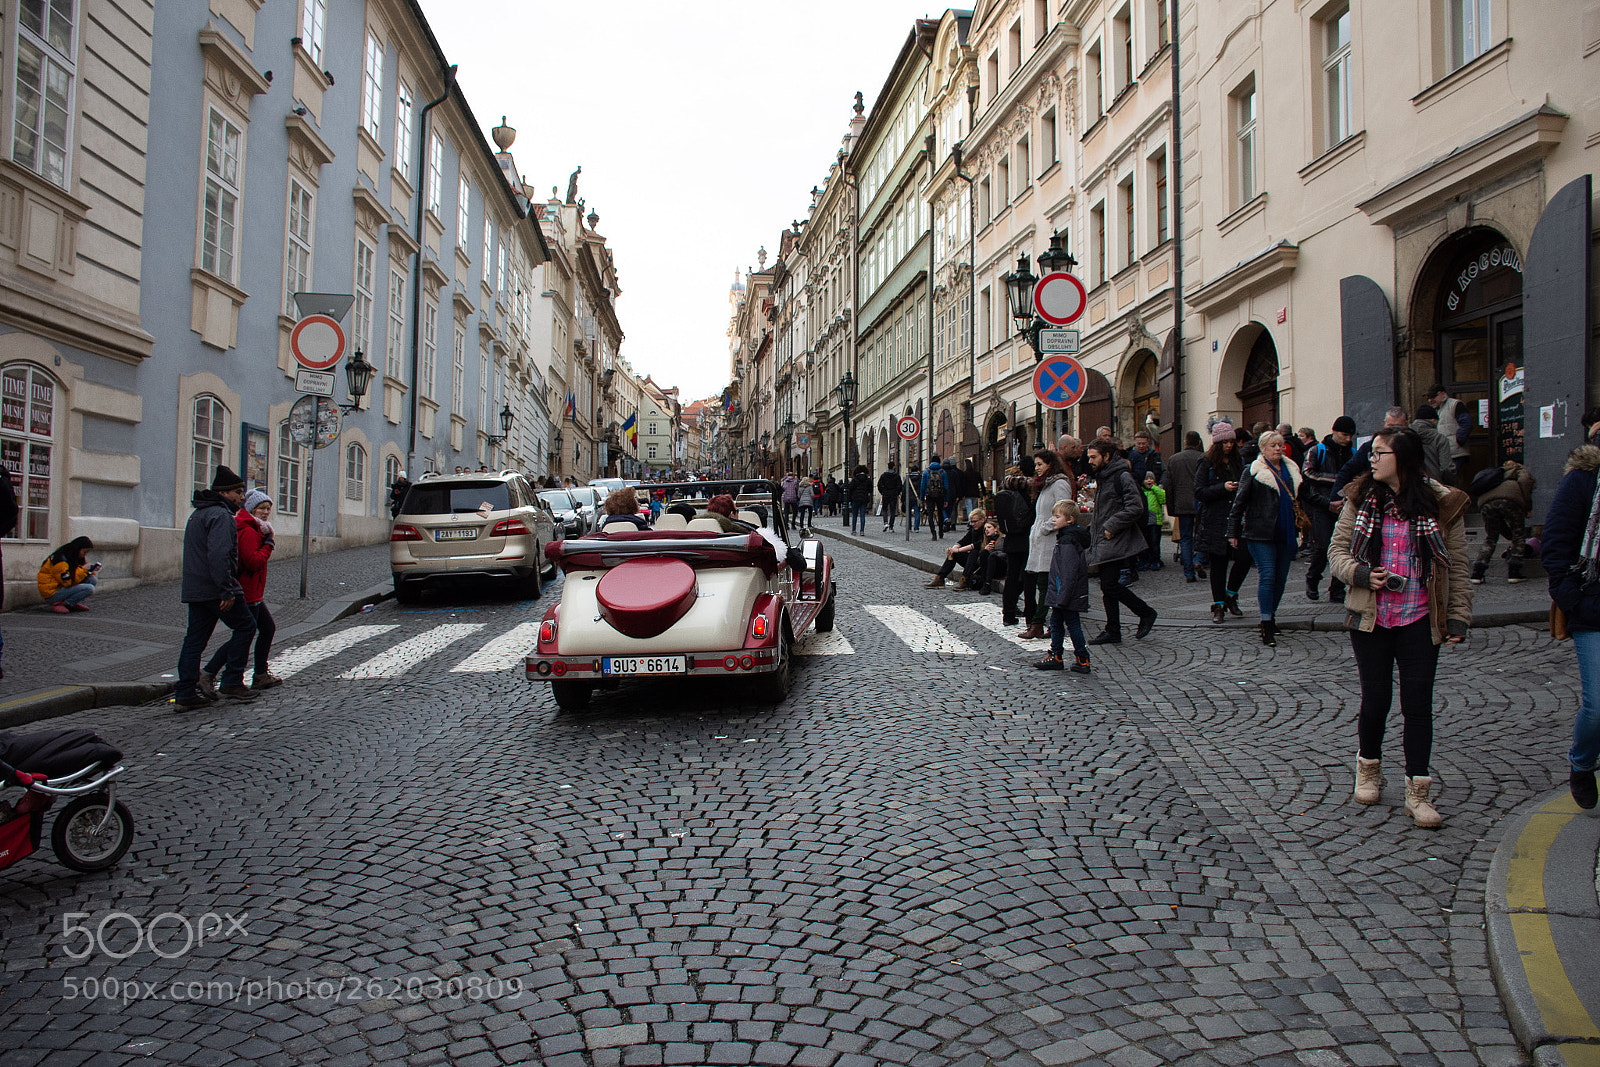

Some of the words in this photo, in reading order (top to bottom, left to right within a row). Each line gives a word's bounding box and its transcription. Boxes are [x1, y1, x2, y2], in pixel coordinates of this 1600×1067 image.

[4, 376, 25, 396] TIME
[32, 383, 51, 402] TIME
[2, 403, 25, 420] MUSIC
[31, 409, 51, 425] MUSIC
[902, 422, 915, 433] 30
[440, 530, 453, 538] 2AY
[613, 659, 637, 673] 9U3
[647, 658, 679, 672] 6614
